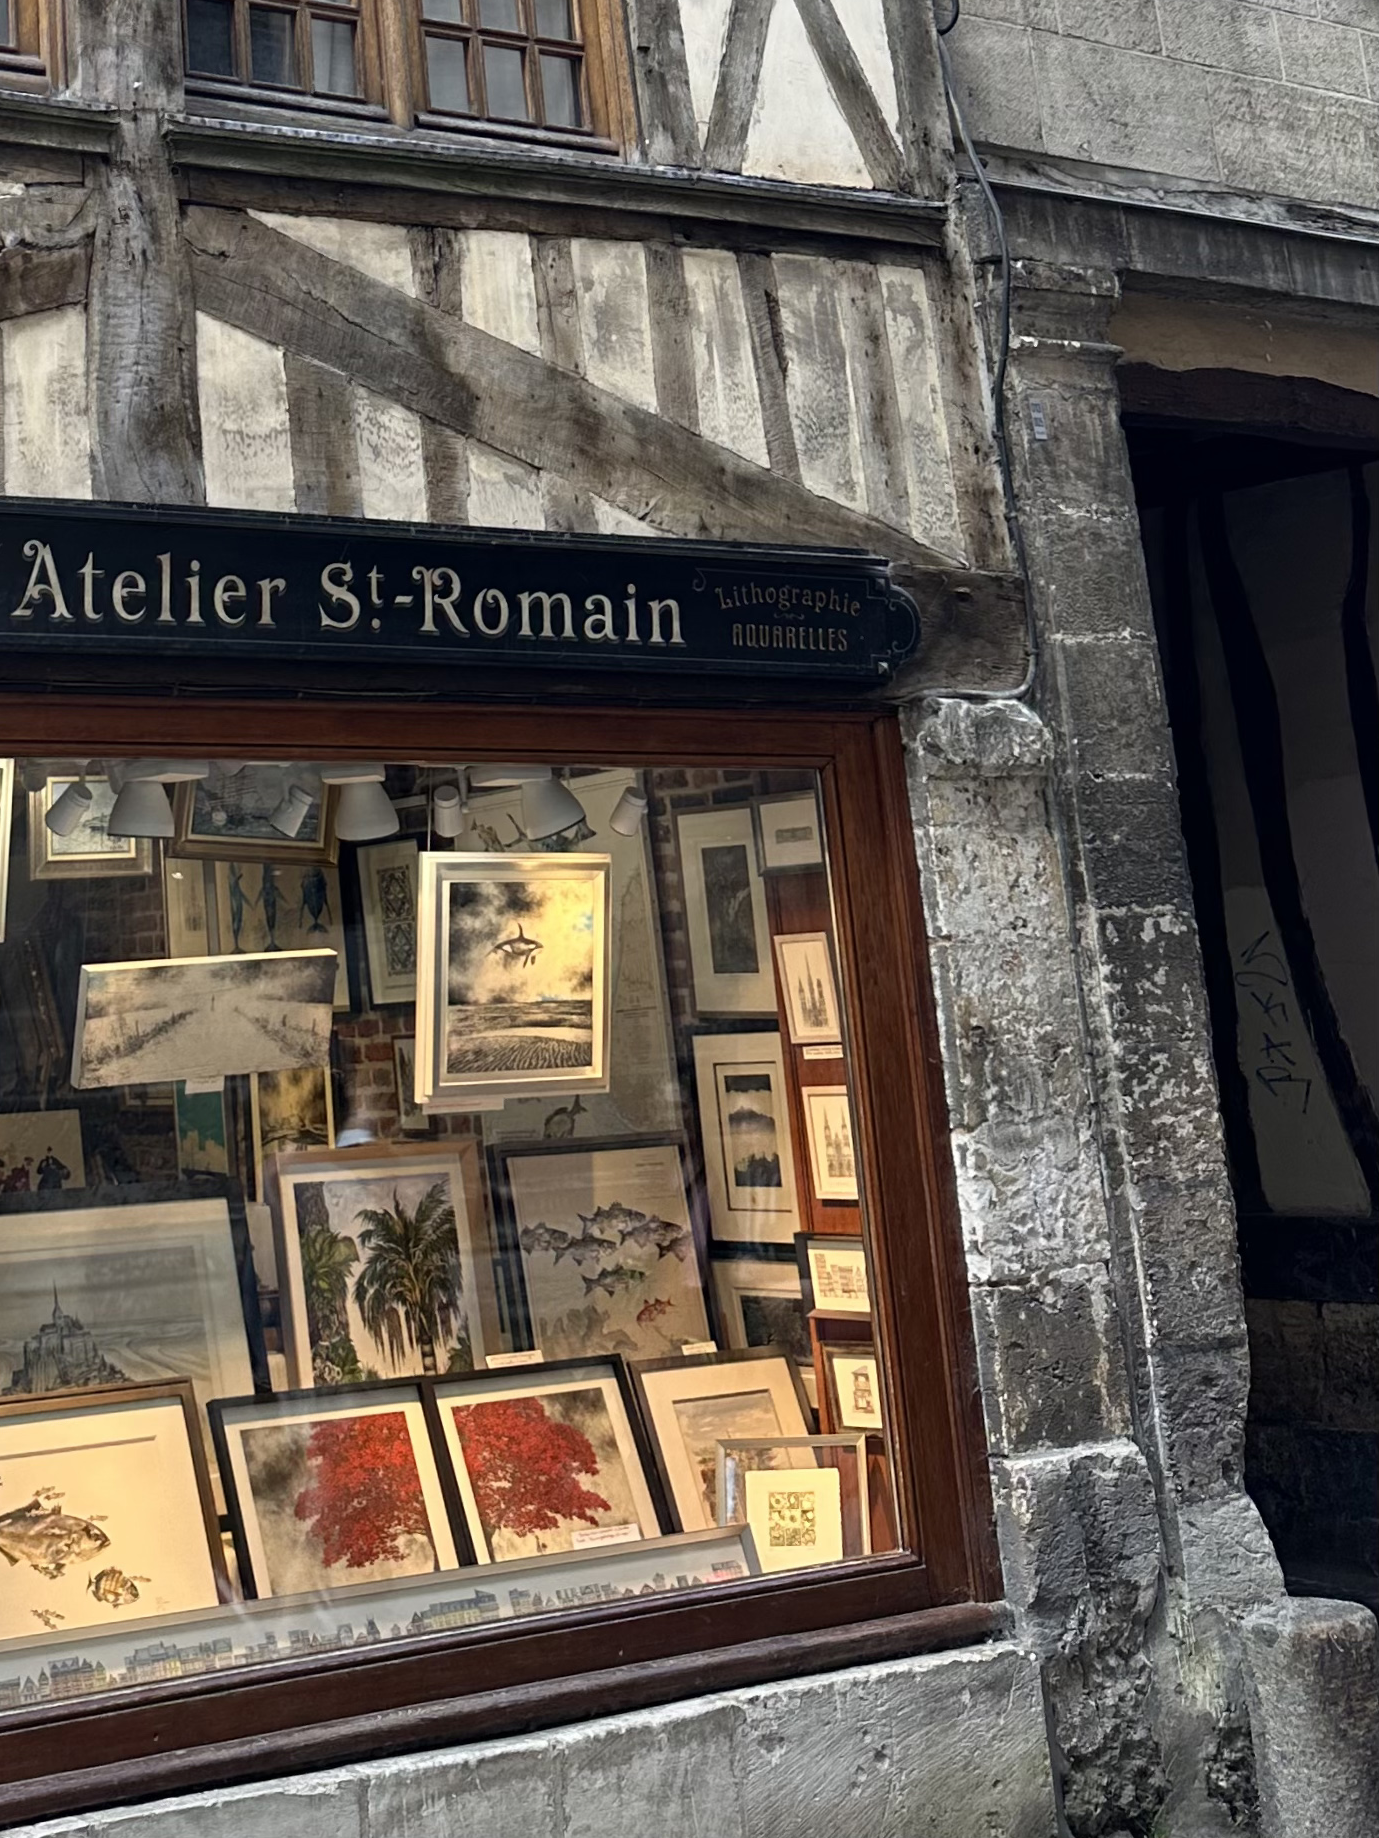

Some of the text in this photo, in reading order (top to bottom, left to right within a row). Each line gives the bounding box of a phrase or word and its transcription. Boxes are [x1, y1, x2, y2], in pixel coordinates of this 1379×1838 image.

[11, 539, 287, 628] Atelier
[715, 581, 861, 617] Lithographie
[732, 622, 848, 652] AQUARELLES
